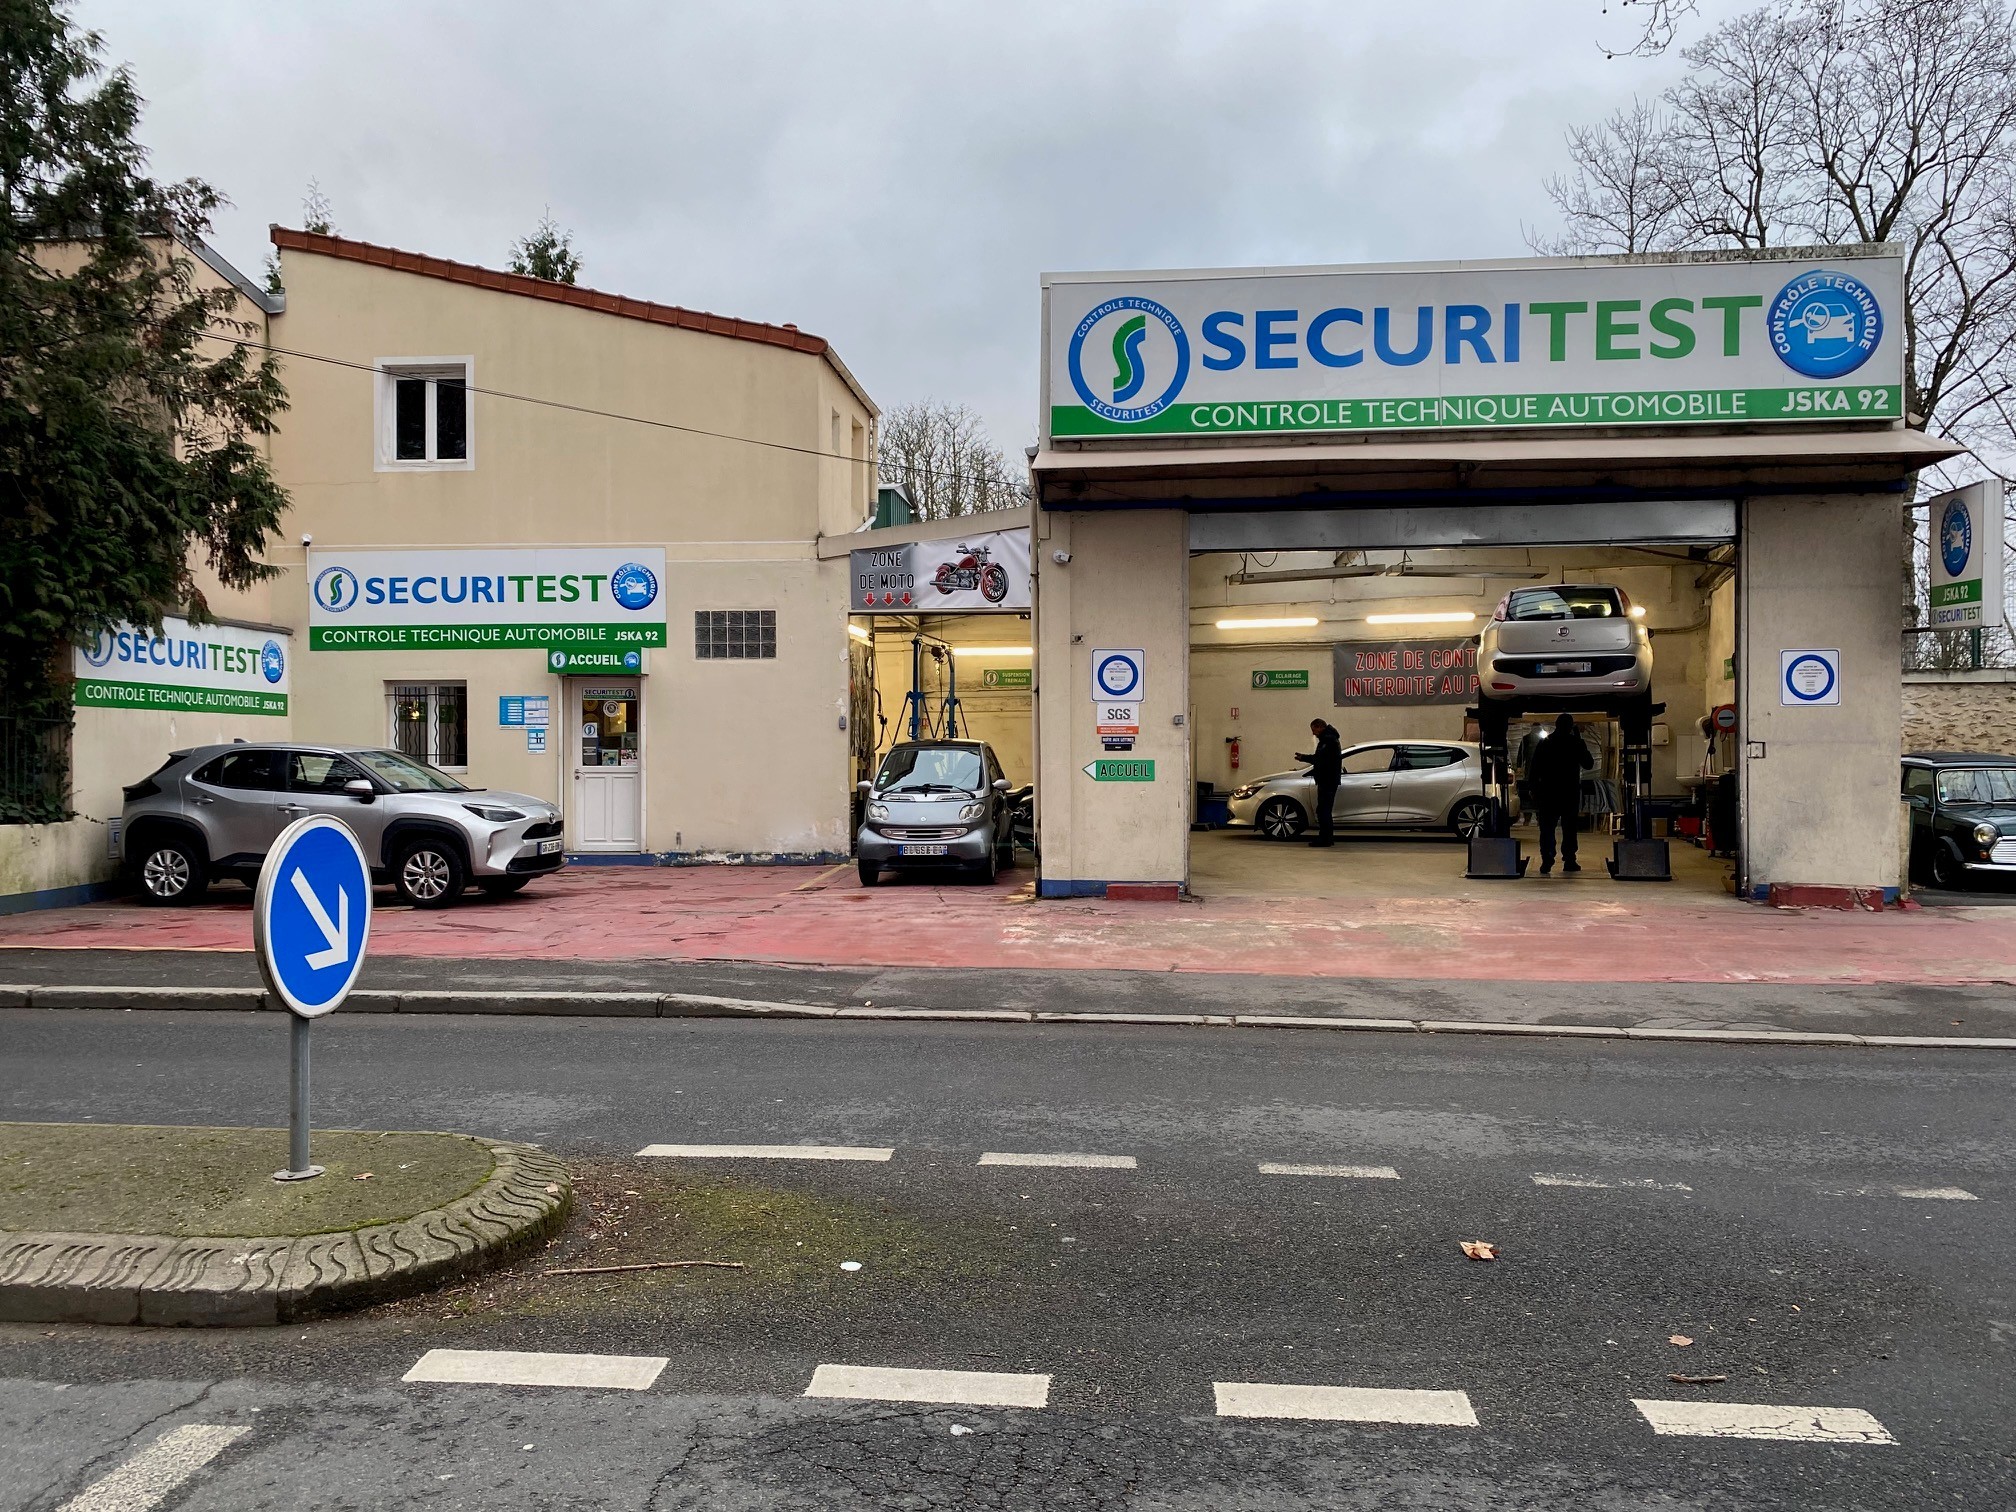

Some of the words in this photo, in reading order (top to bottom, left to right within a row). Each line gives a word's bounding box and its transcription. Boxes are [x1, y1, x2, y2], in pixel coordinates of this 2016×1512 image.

[1077, 300, 1125, 338] CONTROLE
[1128, 300, 1181, 336] TECHNIQUE
[1775, 276, 1819, 354] CONTRÔLE
[1824, 276, 1880, 351] TECHNIQUE
[1202, 295, 1762, 371] SECURITEST
[1090, 398, 1164, 420] SECURITEST
[1191, 402, 1352, 427] CONTROLE
[1362, 397, 1537, 424] TECHNIQUE
[1548, 392, 1746, 418] AUTOMOBILE
[1781, 390, 1851, 412] JSKA
[1857, 388, 1888, 411] 92
[871, 551, 902, 567] ZONE
[365, 575, 607, 605] SECURITEST
[859, 574, 875, 591] DE
[880, 573, 915, 590] MOTO
[1943, 587, 1959, 601] JSKA
[1960, 585, 1969, 599] 92
[1938, 606, 1981, 624] SECURITEST
[322, 629, 407, 644] CONTROLE
[411, 628, 500, 643] TECHNIQUE
[504, 628, 607, 642] AUTOMOBILE
[614, 631, 643, 642] JSKA
[645, 630, 658, 641] 92
[117, 632, 261, 675] SECURITEST
[568, 654, 621, 666] ACCUEIL
[1355, 650, 1397, 672] ZONE
[1403, 650, 1424, 670] DE
[1431, 648, 1476, 669] CONT
[85, 685, 145, 702] CONTROLE
[148, 688, 204, 706] TECHNIQUE
[206, 693, 260, 708] AUTOMOBILE
[1345, 675, 1435, 697] INTERDITE
[1441, 675, 1465, 695] AU
[262, 701, 277, 710] JSKA
[277, 702, 284, 711] 92
[1107, 708, 1130, 720] SGS
[1100, 763, 1150, 777] ACCUEIL
